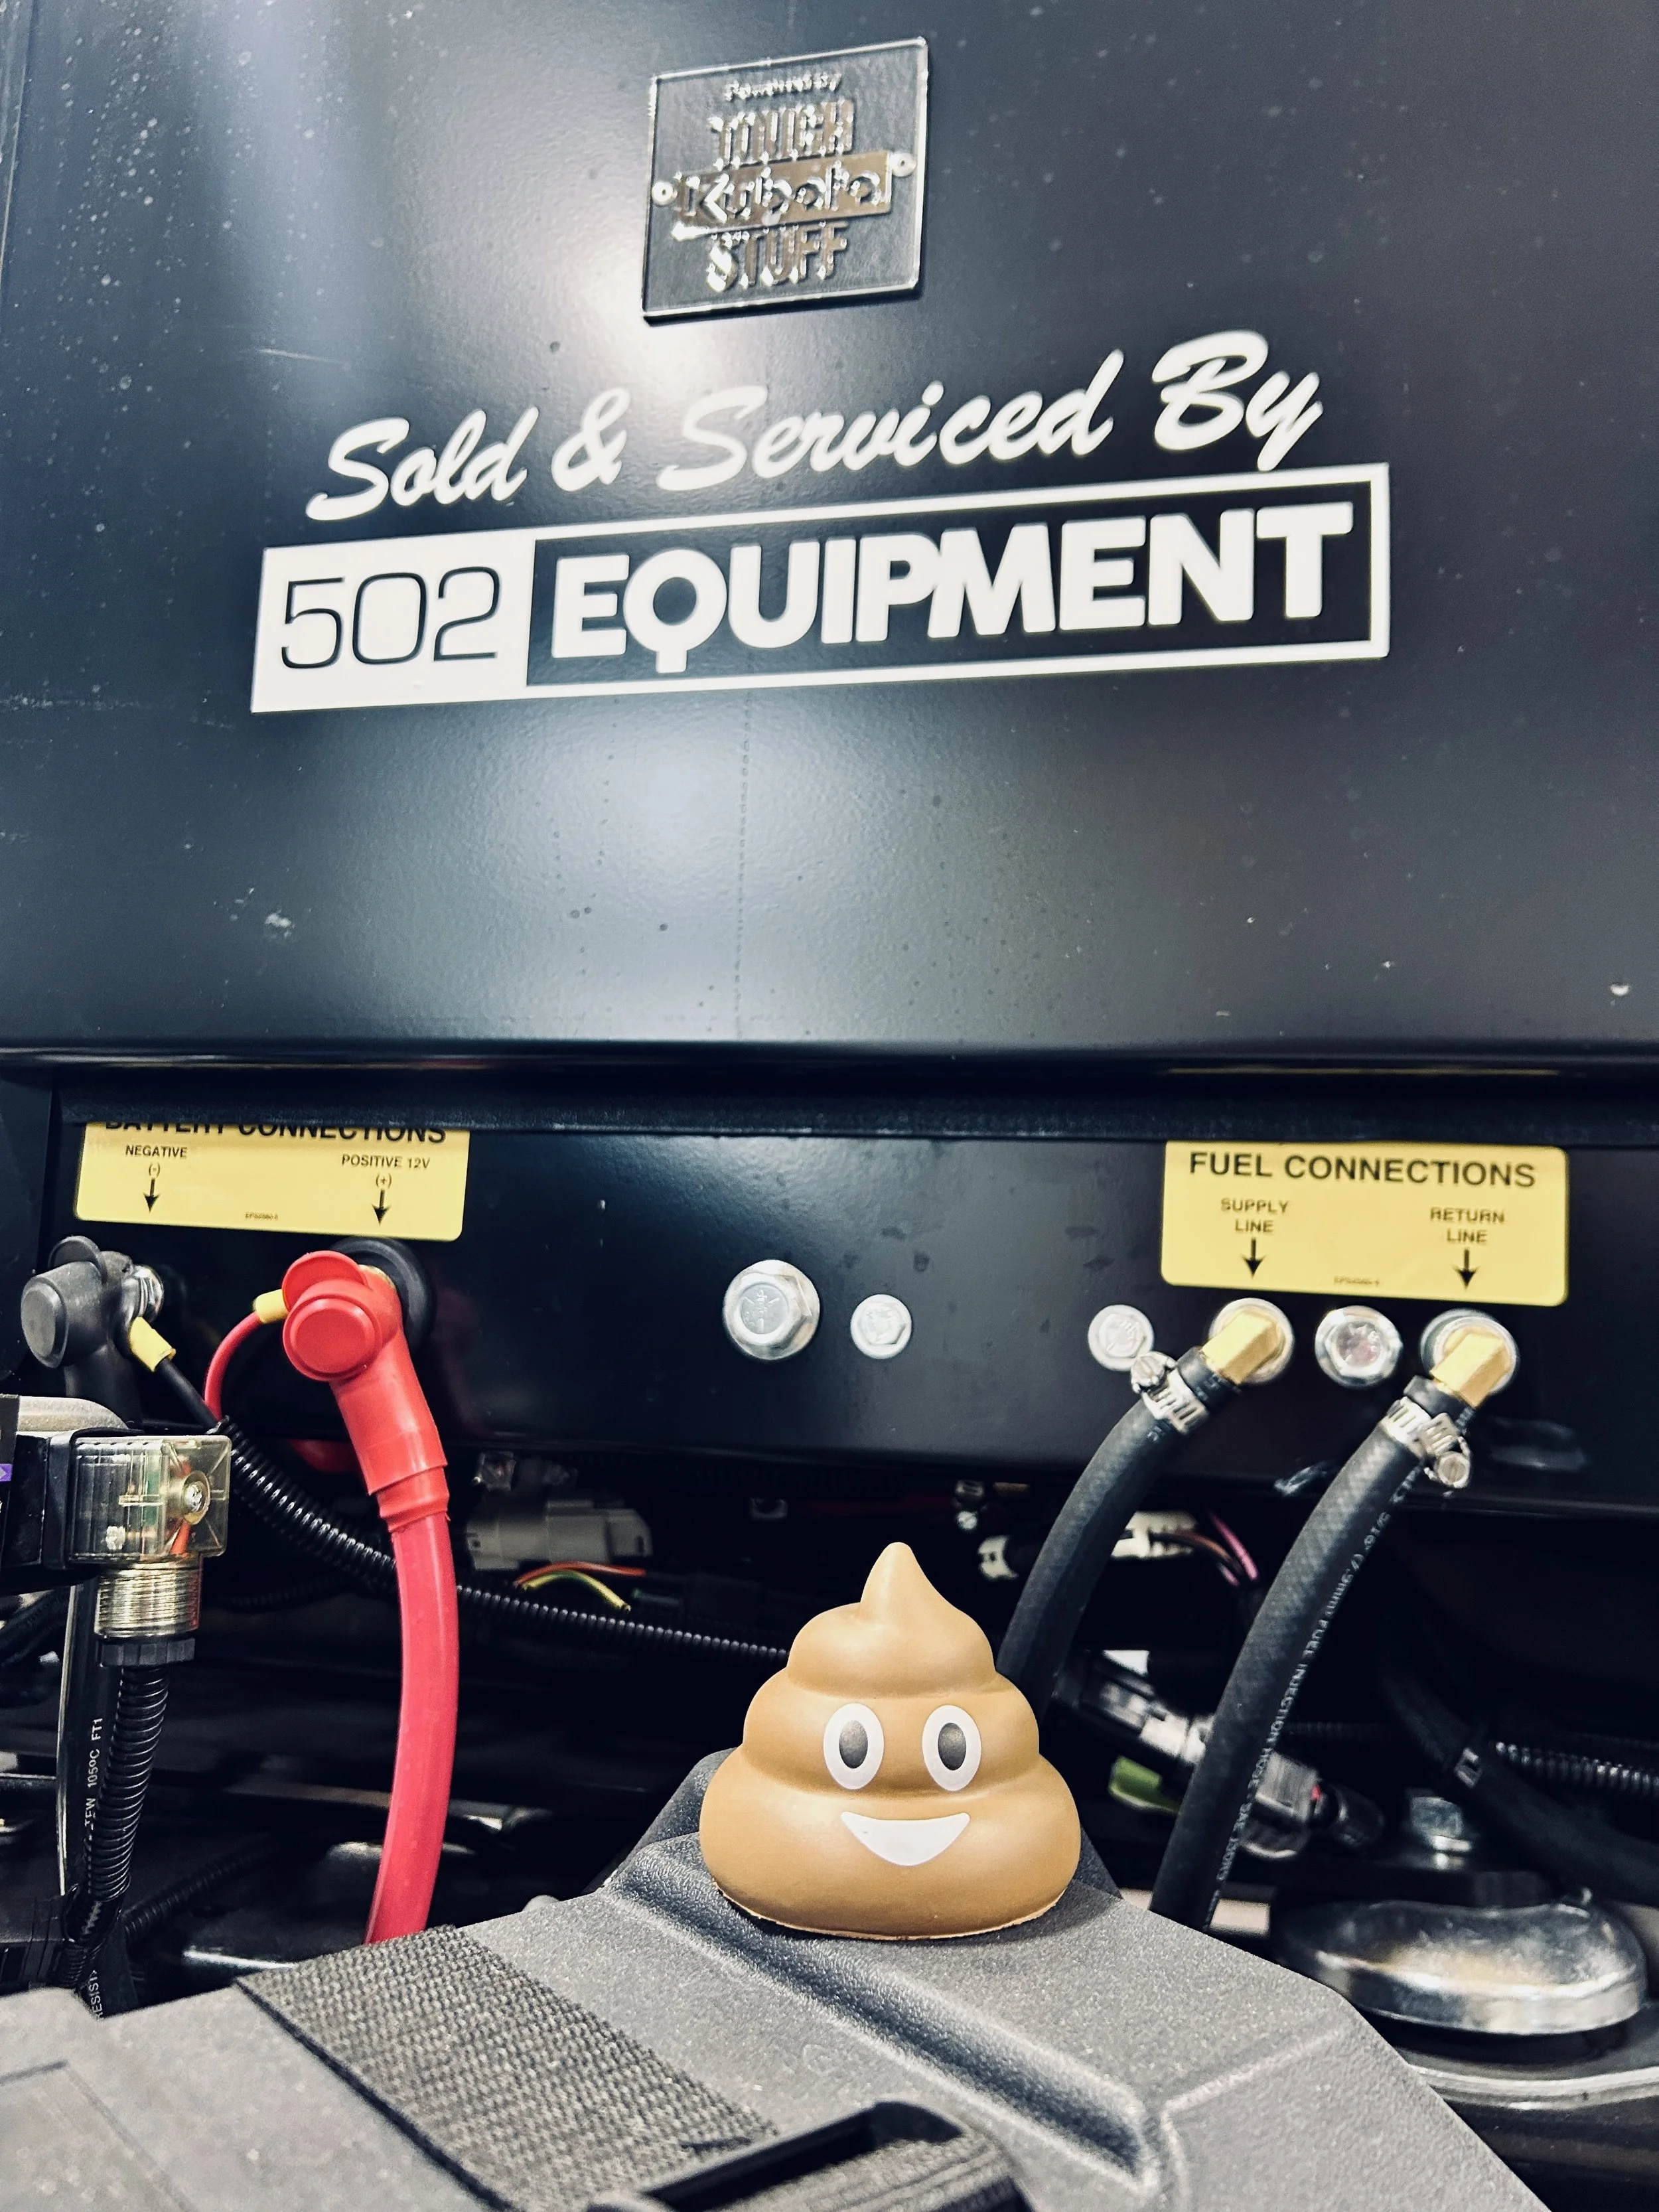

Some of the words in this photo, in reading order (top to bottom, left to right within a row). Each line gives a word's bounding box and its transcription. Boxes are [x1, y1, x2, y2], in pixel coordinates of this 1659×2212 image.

[684, 160, 885, 224] Kubota
[707, 222, 848, 292] STUFF
[305, 407, 539, 521] Sold
[550, 386, 630, 492] &
[656, 349, 1125, 492] Serviced
[1151, 329, 1324, 472] By
[550, 501, 1354, 674] EQUIPMENT
[280, 566, 500, 670] 502
[125, 1144, 188, 1158] NEGATIVE
[341, 1153, 402, 1168] POSITIVE
[407, 1157, 431, 1169] 12V
[1189, 1151, 1273, 1177] FUEL
[1284, 1154, 1536, 1188] CONNECTIONS
[1220, 1197, 1289, 1214] SUPPLY
[1429, 1207, 1506, 1224] RETURN
[1234, 1218, 1275, 1233] LINE
[1446, 1228, 1488, 1244] LINE
[92, 1718, 103, 1741] FT1
